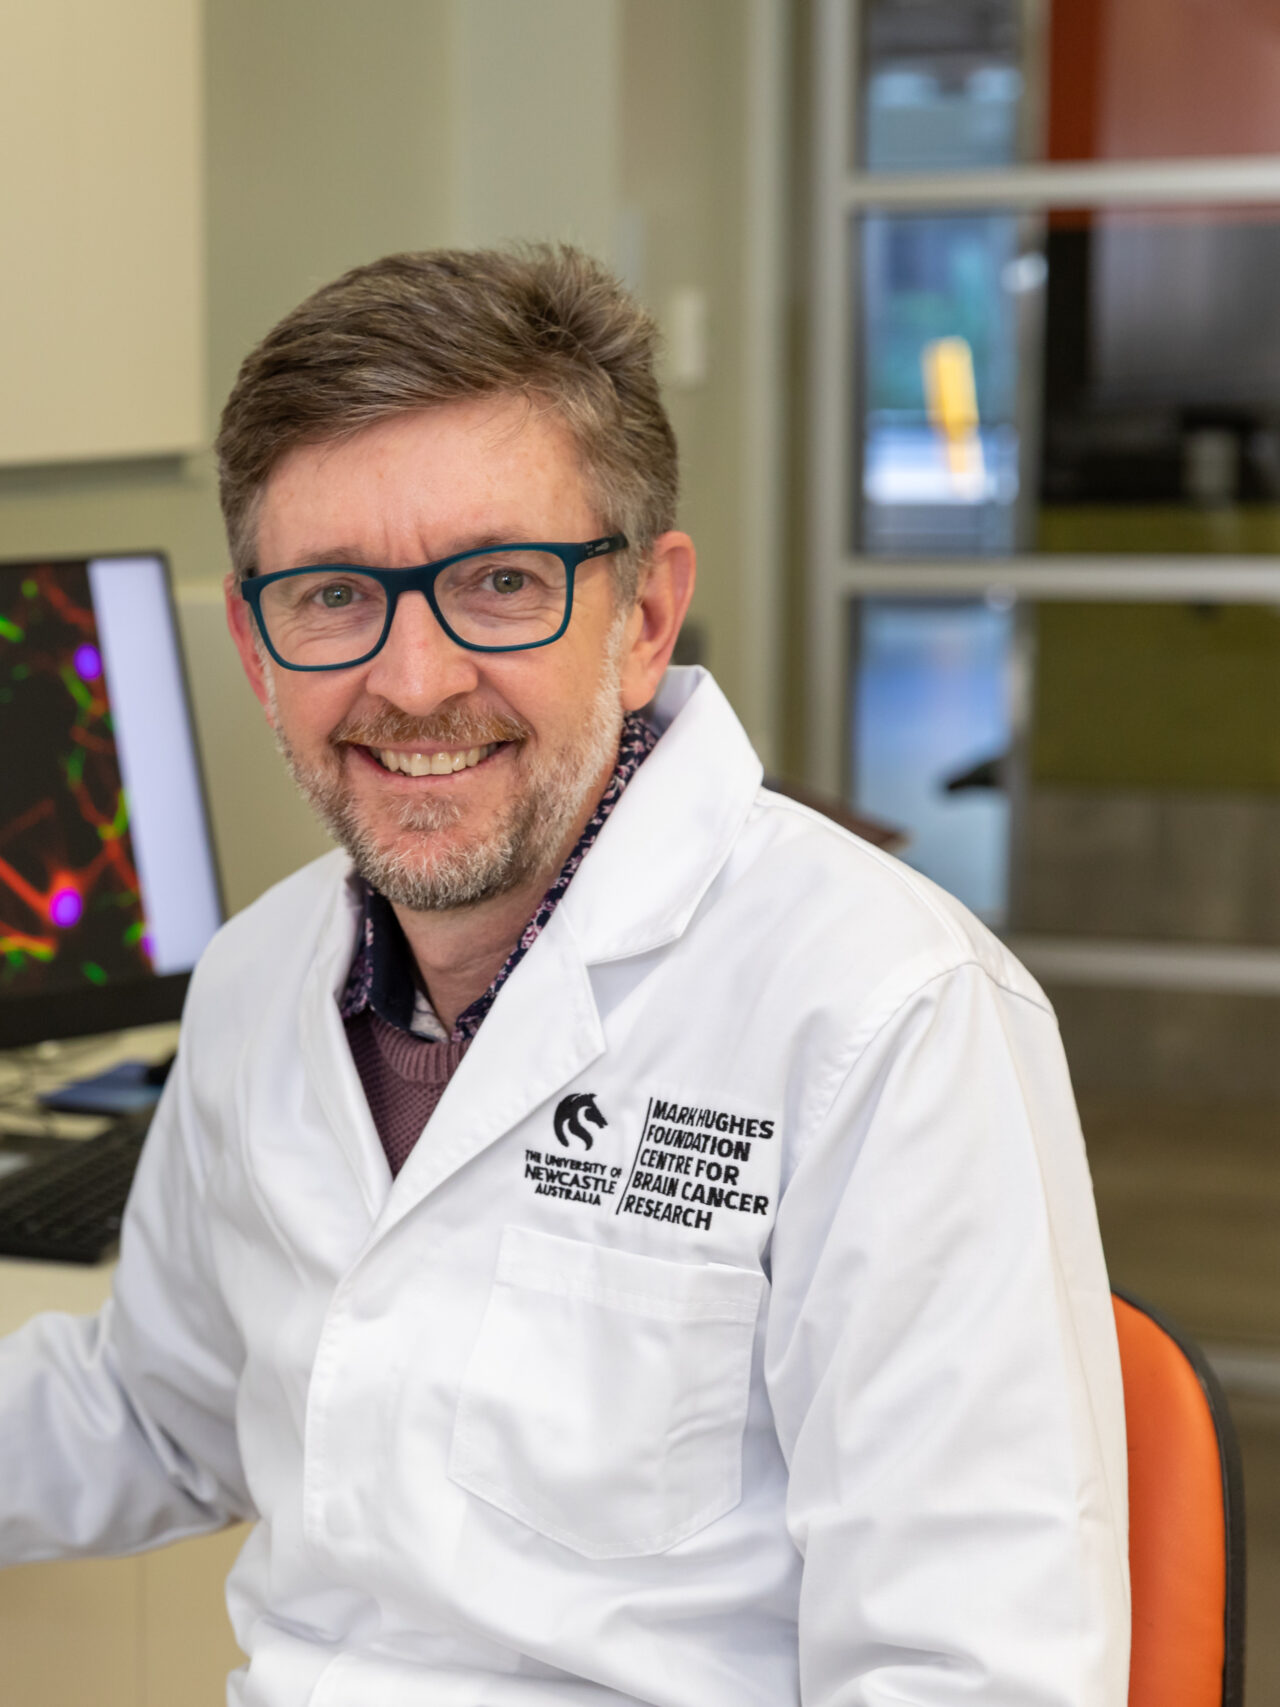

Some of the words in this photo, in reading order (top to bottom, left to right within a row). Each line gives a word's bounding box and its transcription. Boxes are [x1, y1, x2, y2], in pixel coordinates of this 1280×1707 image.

[652, 1099, 698, 1126] MARK
[696, 1107, 775, 1140] HUGHES
[646, 1124, 752, 1162] FOUNDATION
[524, 1163, 617, 1194] NEWCASTLE
[525, 1149, 541, 1163] THE
[545, 1153, 607, 1175] UNIVERSITY
[610, 1167, 622, 1178] OF
[639, 1148, 694, 1175] CENTRE
[694, 1158, 740, 1186] FOR
[534, 1183, 601, 1206] AUSTRALIA
[631, 1170, 680, 1197] BRAIN
[680, 1181, 769, 1216] CANCER
[623, 1194, 713, 1231] RESEARCH
